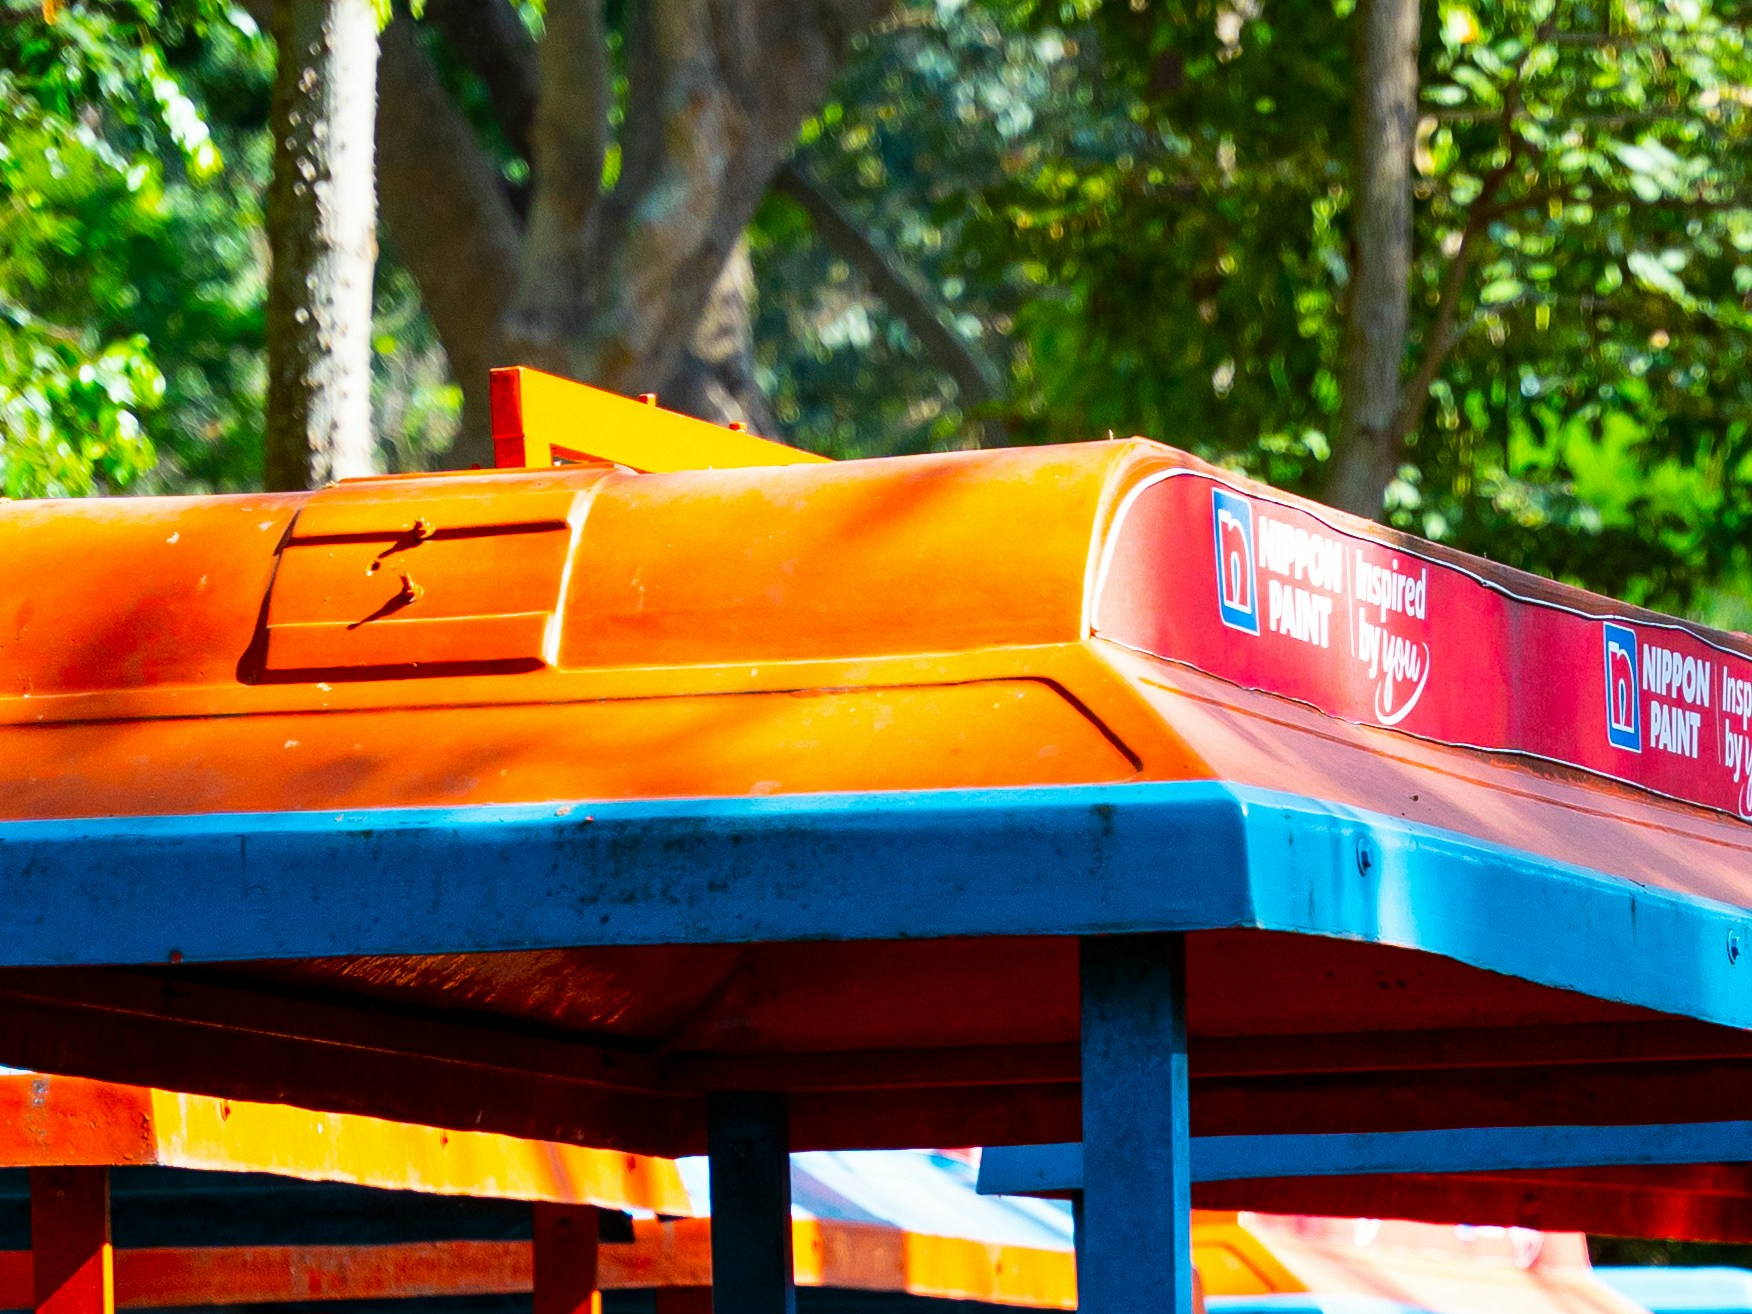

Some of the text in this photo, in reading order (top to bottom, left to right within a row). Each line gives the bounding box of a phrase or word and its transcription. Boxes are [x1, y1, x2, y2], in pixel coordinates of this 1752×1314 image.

[1258, 515, 1343, 593] NIPPON
[1355, 549, 1427, 624] Inspired
[1268, 579, 1333, 649] PAINT
[1358, 606, 1422, 713] by you
[1642, 643, 1711, 708] NIPPON
[1649, 700, 1701, 759] PAINT
[1724, 718, 1744, 783] by
